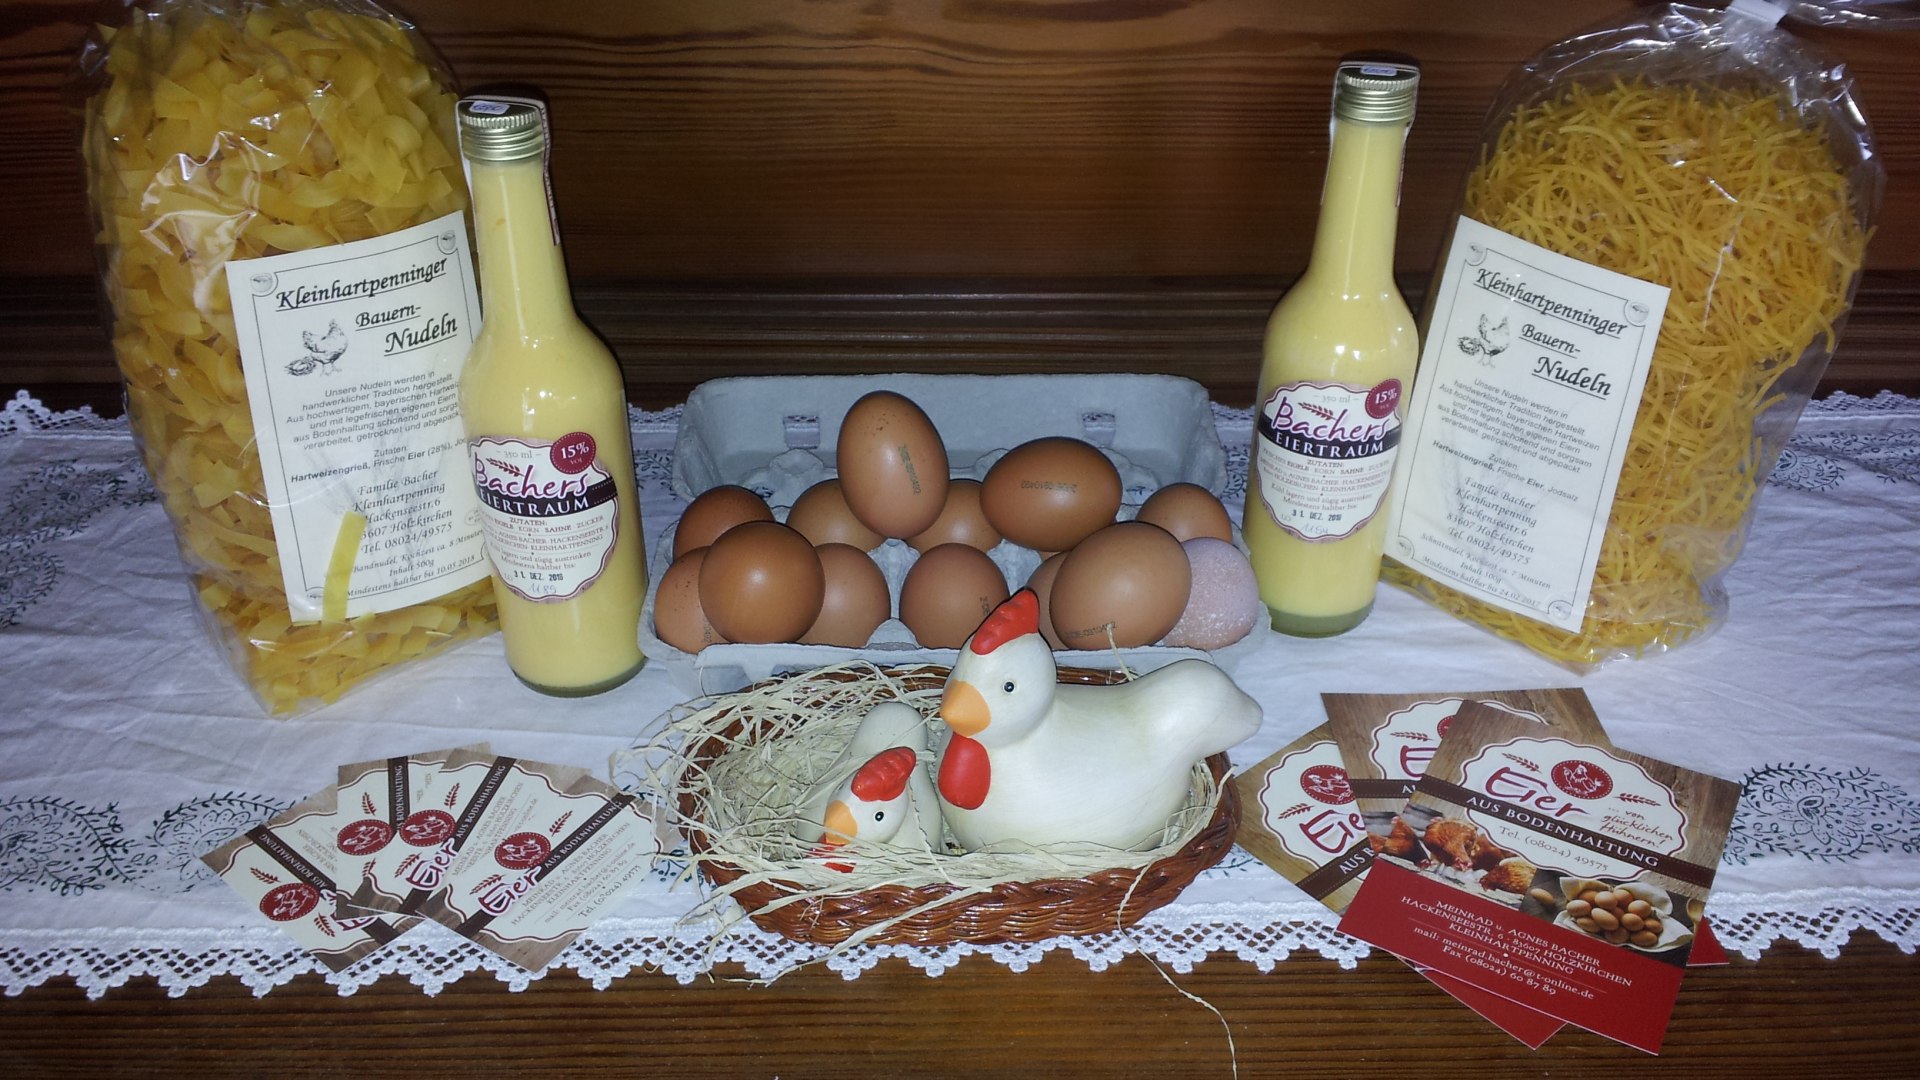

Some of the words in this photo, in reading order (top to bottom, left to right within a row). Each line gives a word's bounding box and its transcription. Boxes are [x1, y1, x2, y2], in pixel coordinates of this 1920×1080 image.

[276, 258, 447, 309] Kleinhartpenninger
[356, 305, 422, 328] Bauern-
[1477, 268, 1628, 335] Kleinhartpenninger
[385, 313, 458, 353] Nudeln
[1522, 324, 1581, 354] Bauern-
[325, 386, 357, 398] Unsere
[360, 380, 392, 391] Nudeln
[394, 374, 426, 385] werden
[1534, 356, 1612, 395] Nudeln
[286, 415, 304, 424] Aus
[306, 403, 372, 420] hochwertigem,
[375, 393, 427, 408] bayerischen
[302, 392, 370, 411] handwerklicher
[373, 386, 411, 399] Tradition
[310, 421, 327, 429] und
[330, 416, 343, 426] mit
[345, 407, 399, 423] legefrischen
[402, 400, 435, 412] eigenen
[437, 393, 456, 404] Eiern
[1375, 387, 1397, 405] 15%
[1474, 378, 1500, 394] Unsere
[1502, 389, 1528, 404] Nudeln
[1530, 400, 1559, 415] werden
[1509, 402, 1542, 420] Tradition
[293, 434, 310, 443] aus
[313, 422, 375, 439] Bodenhaltung
[377, 414, 419, 427] schonend
[421, 409, 437, 419] und
[357, 427, 402, 443] getrocknet
[405, 422, 420, 432] und
[1272, 396, 1390, 442] Bachers
[1439, 384, 1452, 395] Aus
[1506, 412, 1553, 433] bayerischen
[1554, 430, 1600, 450] Hartweizen
[561, 442, 589, 459] 15%
[1276, 431, 1383, 458] EIERTRAUM
[1451, 408, 1501, 435] Bodenhaltung
[1502, 430, 1539, 448] schonend
[1540, 445, 1556, 455] und
[1557, 451, 1592, 467] sorgsam
[1526, 430, 1557, 445] eigenen
[1559, 441, 1580, 454] Eiern
[291, 462, 371, 483] Hartweizengrieß,
[373, 455, 405, 467] Frische
[407, 450, 426, 460] Eier
[474, 452, 589, 498] Bachers
[1340, 467, 1364, 475] SAHNE
[1522, 448, 1537, 458] und
[1539, 453, 1581, 473] abgepackt
[353, 482, 446, 512] Kleinhartpenning
[358, 479, 399, 495] Familie
[401, 469, 438, 486] Bacher
[1464, 476, 1499, 497] Familie
[1500, 490, 1536, 511] Bacher
[1548, 485, 1579, 501] Jodsalz
[480, 489, 589, 515] EIERTRAUM
[1456, 487, 1538, 528] Kleinhartpenning
[389, 509, 452, 533] Holzkirchen
[545, 525, 572, 533] SAHNE
[1446, 513, 1476, 530] 83607
[1477, 523, 1535, 553] Holzkirchen
[361, 542, 380, 554] Tel.
[384, 522, 452, 548] 08024/49575
[1466, 534, 1530, 566] 08024/49575
[348, 582, 392, 597] Mindestens
[394, 573, 422, 587] haltbar
[424, 570, 434, 579] bis
[389, 562, 414, 577] Inhalt
[416, 559, 434, 570] 500g
[455, 822, 471, 838] AUS
[463, 765, 506, 830] BODENHALTUNG
[1485, 766, 1591, 818] Eier
[1601, 814, 1674, 842] glücklichen
[1625, 810, 1645, 820] von
[1466, 796, 1500, 812] AUS
[1506, 808, 1659, 869] BODENHALTUNG
[1599, 823, 1666, 848] Hühnern!
[261, 833, 314, 882] BODENHALTUNG
[544, 854, 560, 869] AUS
[1499, 825, 1521, 840] Tel.
[1524, 834, 1572, 859] (08024)
[1574, 854, 1608, 872] 49575
[1338, 855, 1366, 874] AUS
[310, 873, 329, 889] AUS
[478, 866, 542, 915] Eier
[578, 905, 596, 918] Tel.
[1401, 896, 1492, 936] HACKENSEESTR.
[1497, 932, 1504, 940] 6
[1512, 938, 1540, 954] 83607
[1543, 949, 1632, 987] HOLZKIRCHEN
[1436, 900, 1494, 927] MEINRAD
[1495, 924, 1505, 933] u.
[1508, 928, 1549, 947] AGNES
[1551, 943, 1601, 967] BACHER
[1449, 922, 1575, 976] KLEINHARTPENNING
[1414, 926, 1440, 942] mail:
[1442, 937, 1594, 1000] meinrad.bacher@t-online.de
[1442, 945, 1462, 959] Fax
[1464, 956, 1508, 976] (08024)
[1510, 972, 1524, 982] 60
[1526, 977, 1540, 989] 87
[1542, 983, 1557, 996] 89
